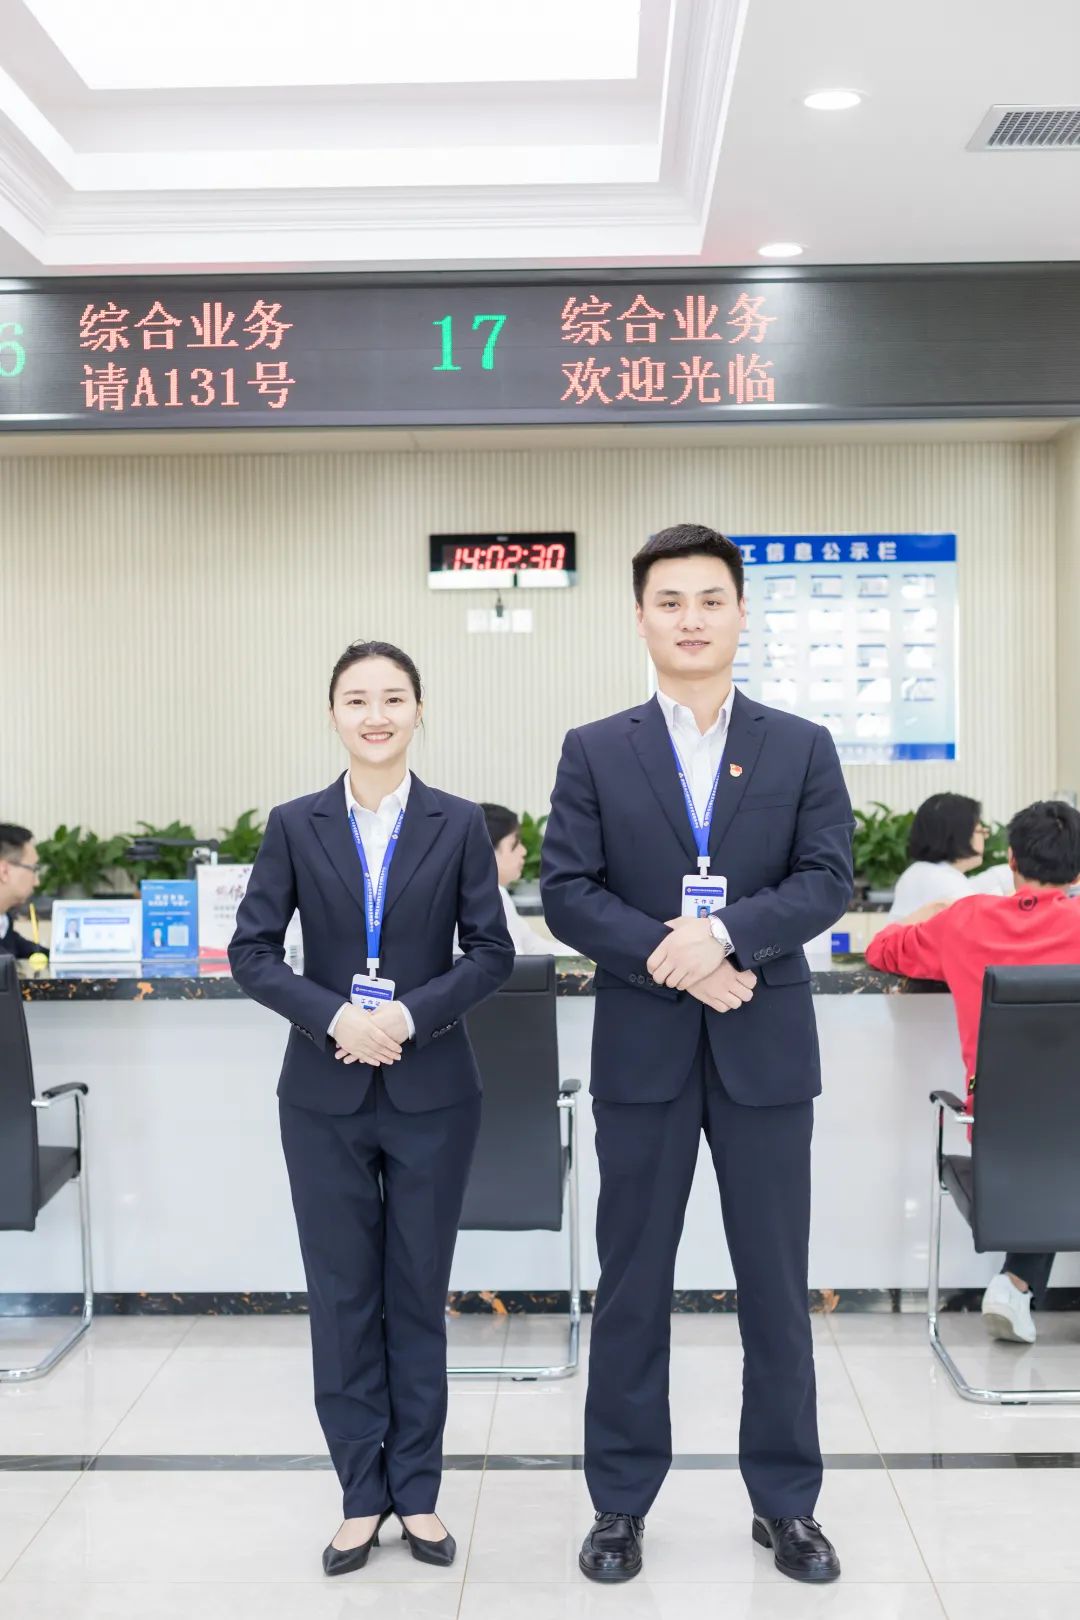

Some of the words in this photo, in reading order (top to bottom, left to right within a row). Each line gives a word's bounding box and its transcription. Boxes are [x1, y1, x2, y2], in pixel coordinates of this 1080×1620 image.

[79, 300, 294, 352] 综合业务
[432, 314, 508, 372] 17
[560, 294, 777, 346] 综合业务
[80, 361, 297, 411] 请A131号
[560, 354, 777, 405] 欢迎光临
[453, 543, 566, 571] 14:02:30
